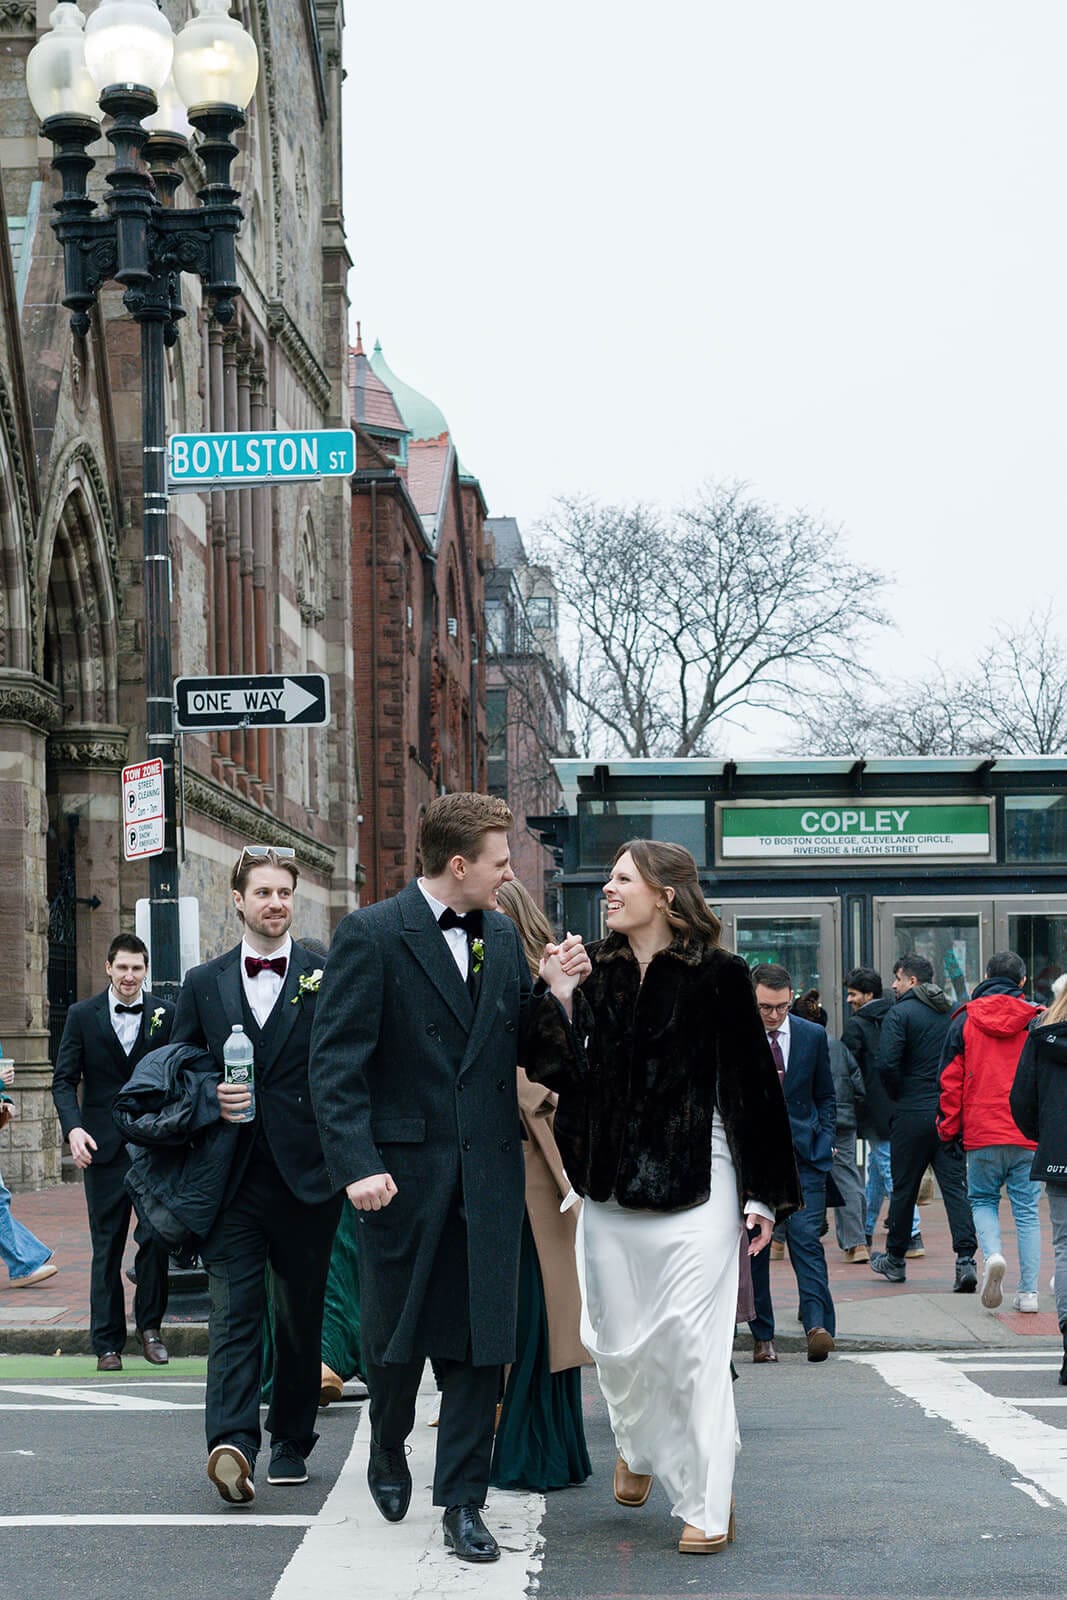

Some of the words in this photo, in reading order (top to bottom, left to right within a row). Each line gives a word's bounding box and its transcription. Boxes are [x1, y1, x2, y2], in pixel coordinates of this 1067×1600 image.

[174, 438, 318, 473] BOYLSTON
[329, 451, 347, 469] ST
[193, 693, 232, 711] ONE
[244, 691, 284, 709] WAY
[125, 768, 140, 781] TOW
[142, 763, 160, 777] ZONE
[138, 779, 154, 790] STREET
[138, 788, 160, 800] CLEANING
[801, 810, 910, 833] COPLEY
[760, 837, 772, 845] TO
[774, 837, 812, 845] BOSTON
[814, 836, 860, 845] COLLEGE,
[861, 836, 915, 844] CLEVELAND
[917, 835, 954, 844] CIRCLE,
[793, 846, 841, 854] RIVERSIDE
[884, 845, 919, 853] STREET
